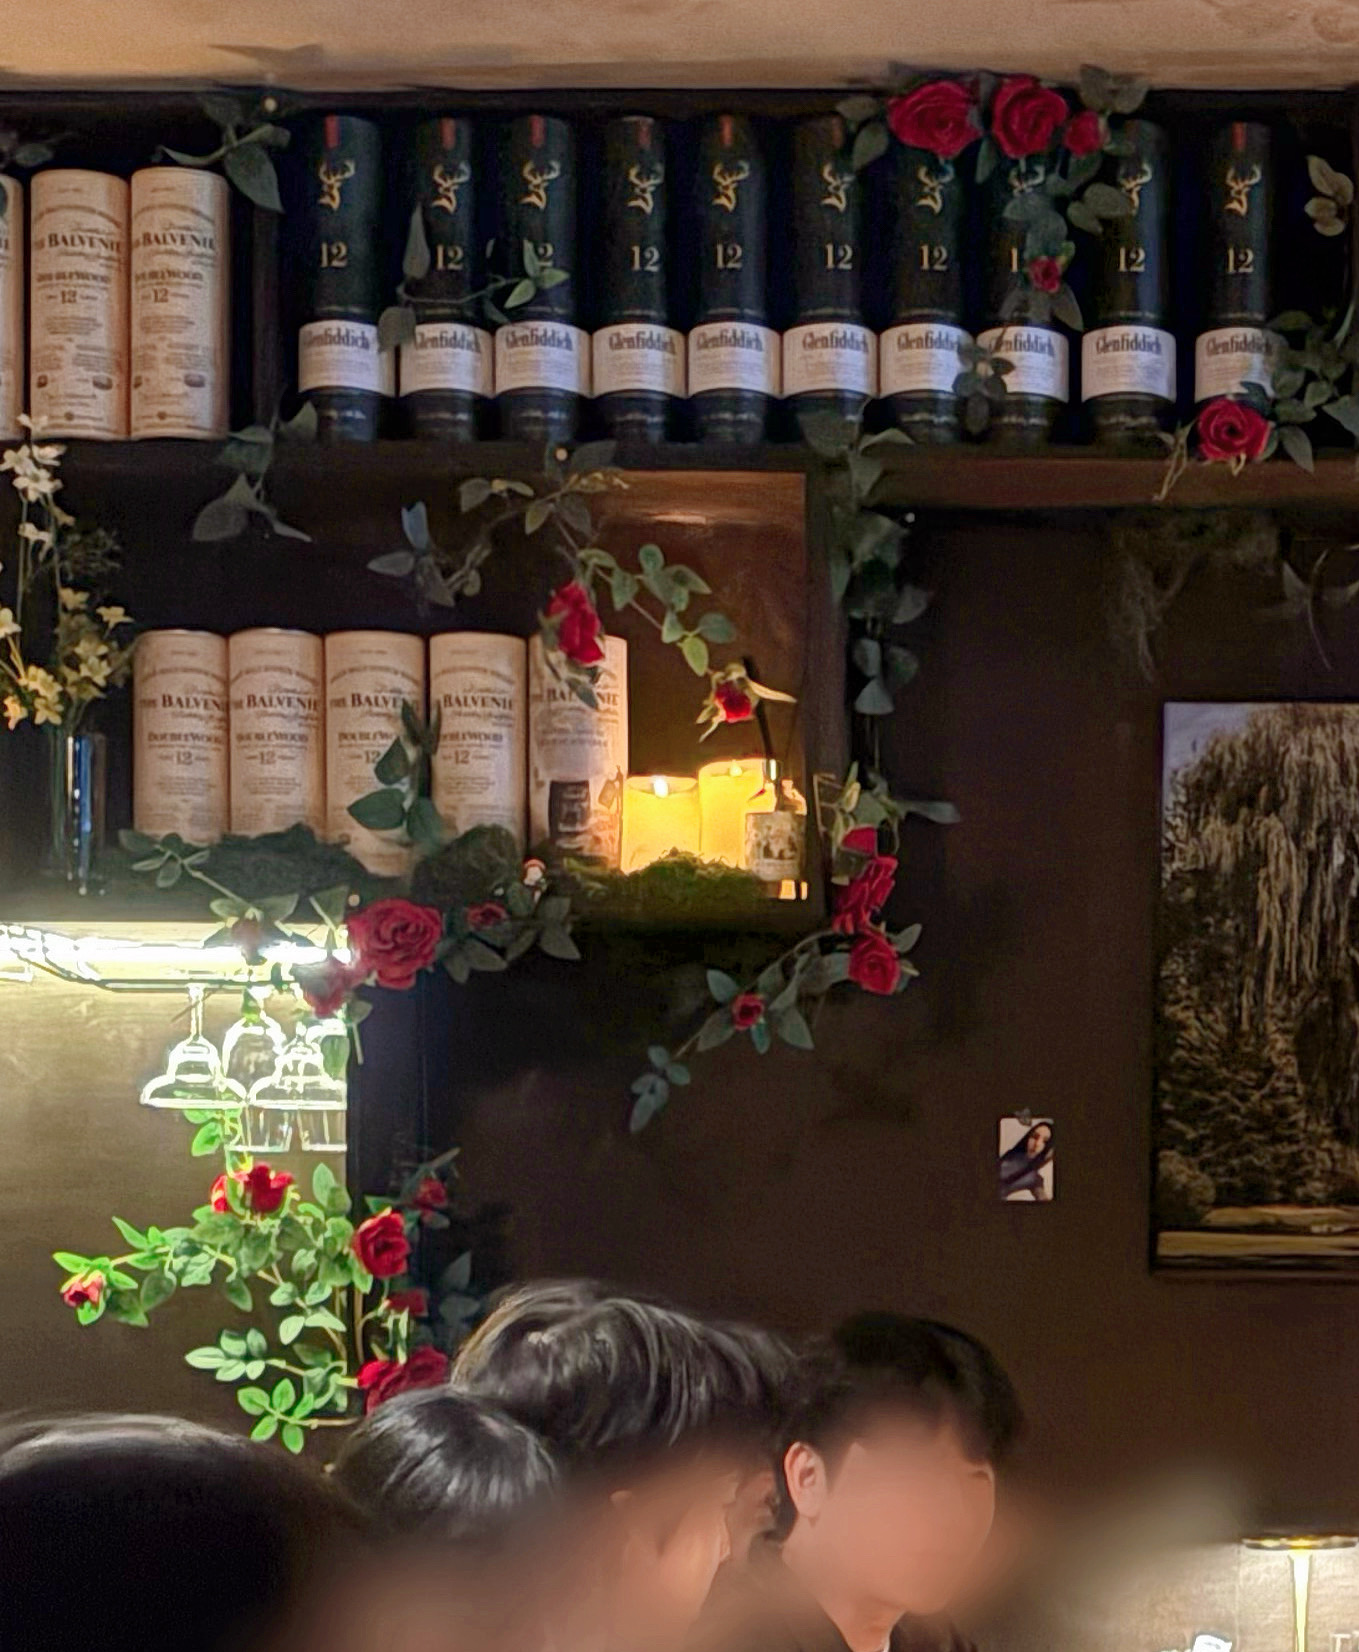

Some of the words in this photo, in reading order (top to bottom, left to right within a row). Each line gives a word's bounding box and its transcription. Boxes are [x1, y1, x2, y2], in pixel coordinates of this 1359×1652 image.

[321, 241, 348, 268] 12
[436, 244, 464, 271] 12
[538, 242, 553, 267] 2
[631, 245, 660, 272] 12
[717, 243, 743, 270] 12
[825, 243, 853, 270] 12
[920, 244, 948, 271] 12
[1118, 246, 1145, 273] 12
[1226, 246, 1254, 274] 12
[547, 688, 618, 706] BALNIE
[259, 751, 276, 765] 12
[454, 750, 470, 763] 12
